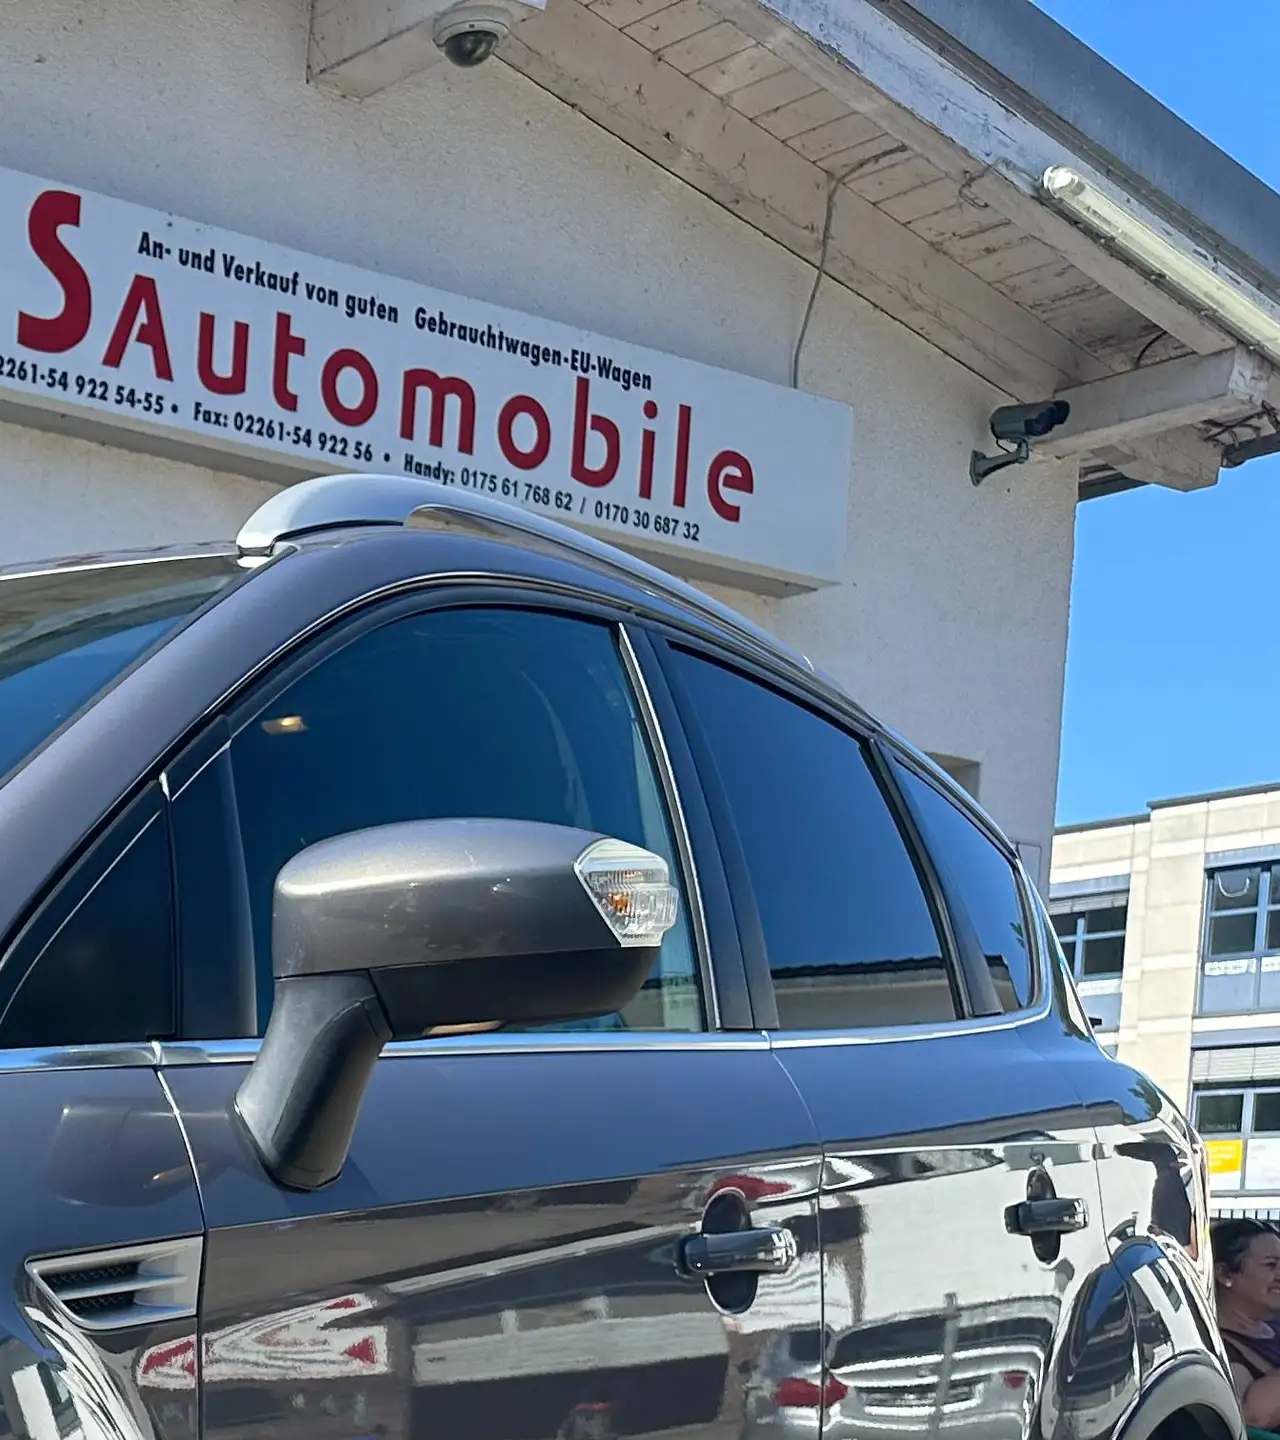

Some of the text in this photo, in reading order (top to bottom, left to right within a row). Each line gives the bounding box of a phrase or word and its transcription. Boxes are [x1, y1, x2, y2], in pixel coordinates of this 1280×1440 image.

[137, 231, 653, 391] An- und Verkauf von guten Gebrauchtwagen-EU-Wagen
[75, 375, 109, 403] 922
[114, 384, 165, 415] 54-55
[193, 401, 228, 428] Fax:
[233, 411, 313, 448] 02261-54
[318, 431, 349, 458] 922
[352, 440, 374, 463] 56
[403, 453, 455, 486] Handy:
[460, 467, 498, 493] 0175
[501, 477, 519, 498] 61
[524, 482, 551, 506] 768
[554, 490, 574, 512] 62
[594, 500, 630, 526] 0170
[632, 509, 651, 529] 30
[653, 513, 680, 537] 687
[682, 520, 701, 543] 32
